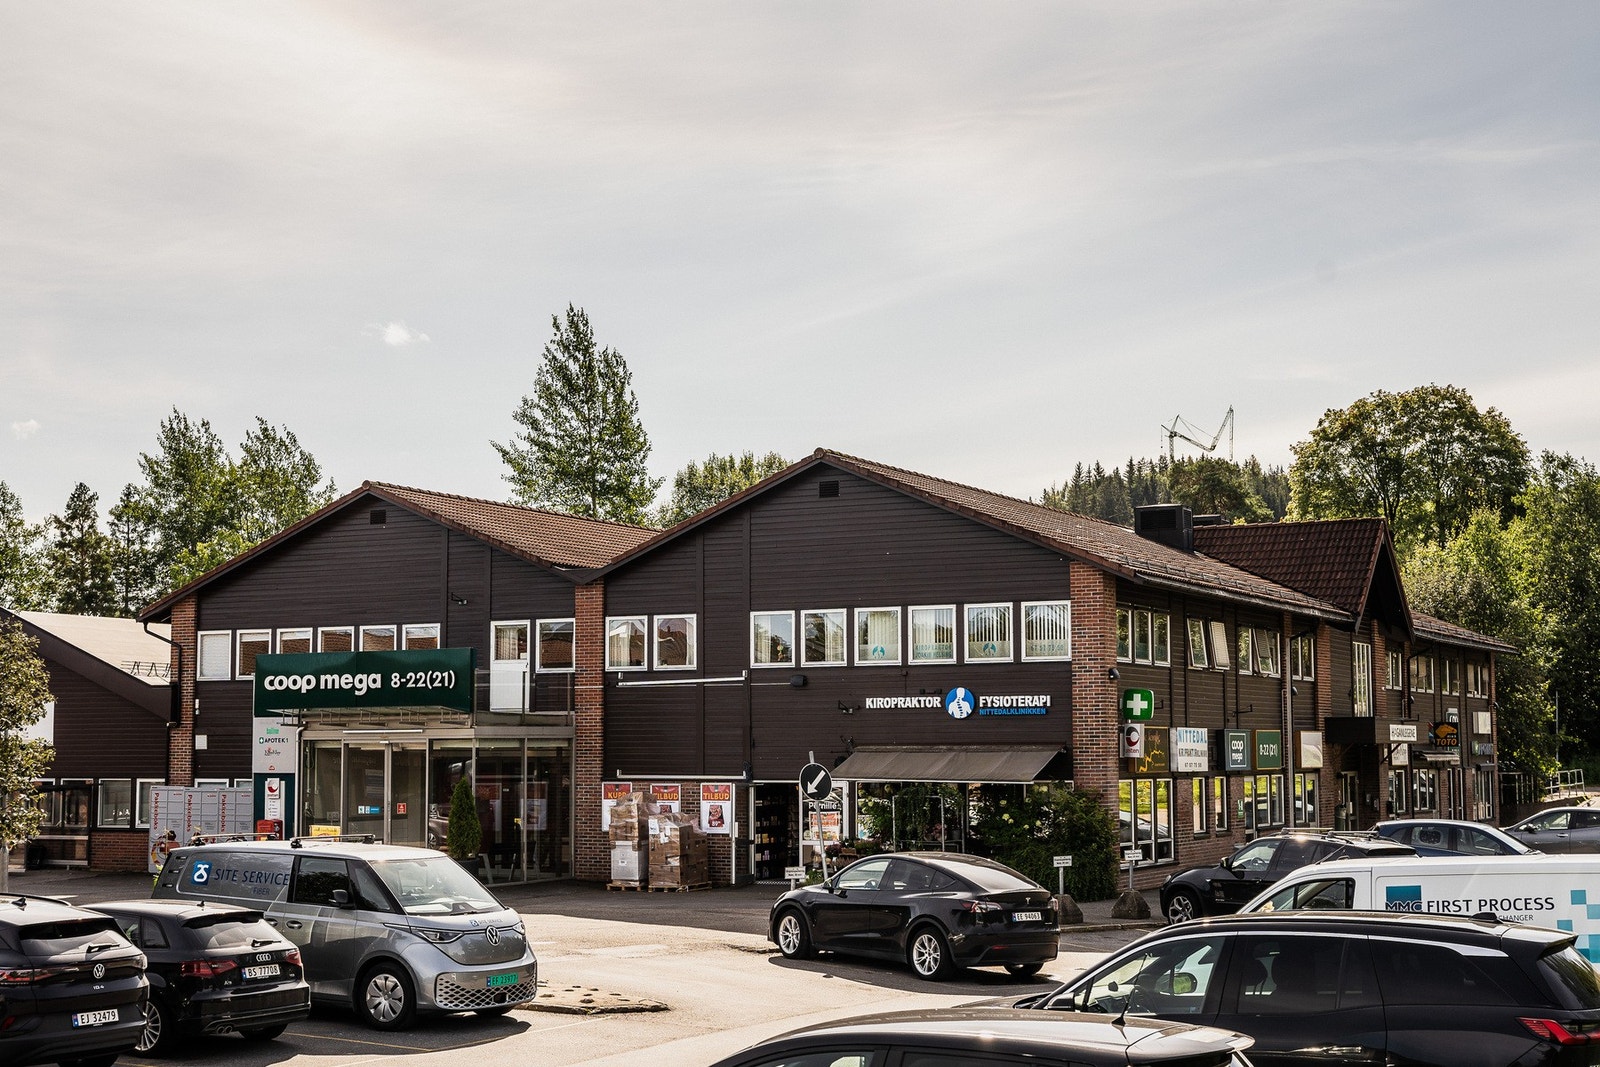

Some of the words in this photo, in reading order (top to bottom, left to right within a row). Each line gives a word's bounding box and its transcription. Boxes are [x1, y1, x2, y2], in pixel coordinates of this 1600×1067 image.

[264, 675, 316, 694] coop
[320, 673, 382, 696] mega
[390, 670, 455, 690] 8-22(21)
[866, 696, 942, 708] KIROPRAKTOR
[980, 696, 1050, 707] FYSIOTERAPI
[1178, 730, 1206, 743] NITTEDAL
[1232, 740, 1244, 752] coop
[1232, 753, 1243, 763] mega
[214, 868, 238, 882] SITE
[242, 870, 290, 885] SERVICE
[253, 887, 270, 895] FIBER
[1385, 901, 1422, 912] MMC
[1428, 900, 1472, 912] FIRST
[1478, 898, 1555, 911] PROCESS
[248, 968, 257, 977] BS
[260, 966, 278, 974] 77708
[81, 1014, 89, 1024] EJ
[93, 1011, 116, 1022] 32479
